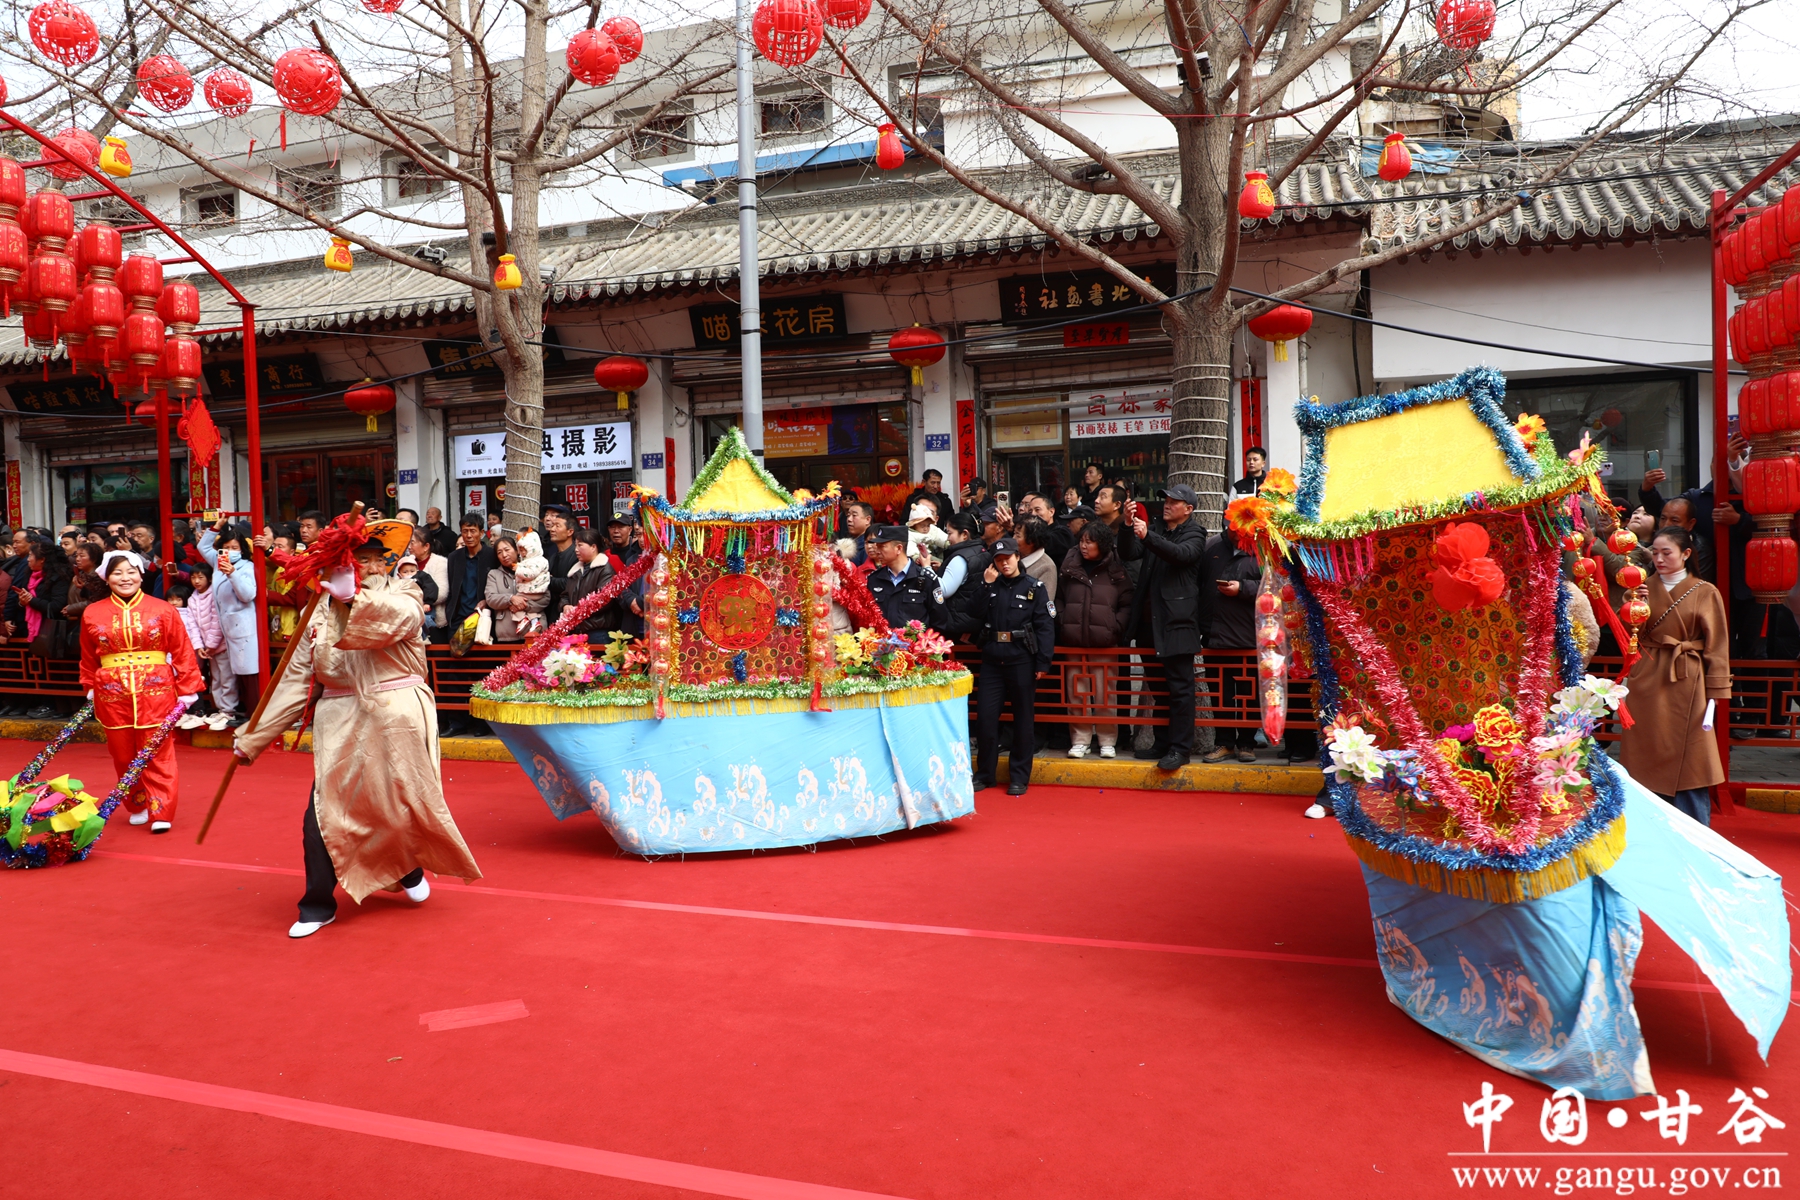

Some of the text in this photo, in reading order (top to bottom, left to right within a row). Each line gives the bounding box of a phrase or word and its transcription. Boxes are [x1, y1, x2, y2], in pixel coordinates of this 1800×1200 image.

[219, 363, 304, 388] 翠商行
[1123, 420, 1144, 433] 毛笔
[501, 427, 617, 462] 典摄影
[122, 468, 145, 492] 茶
[468, 490, 483, 507] 复
